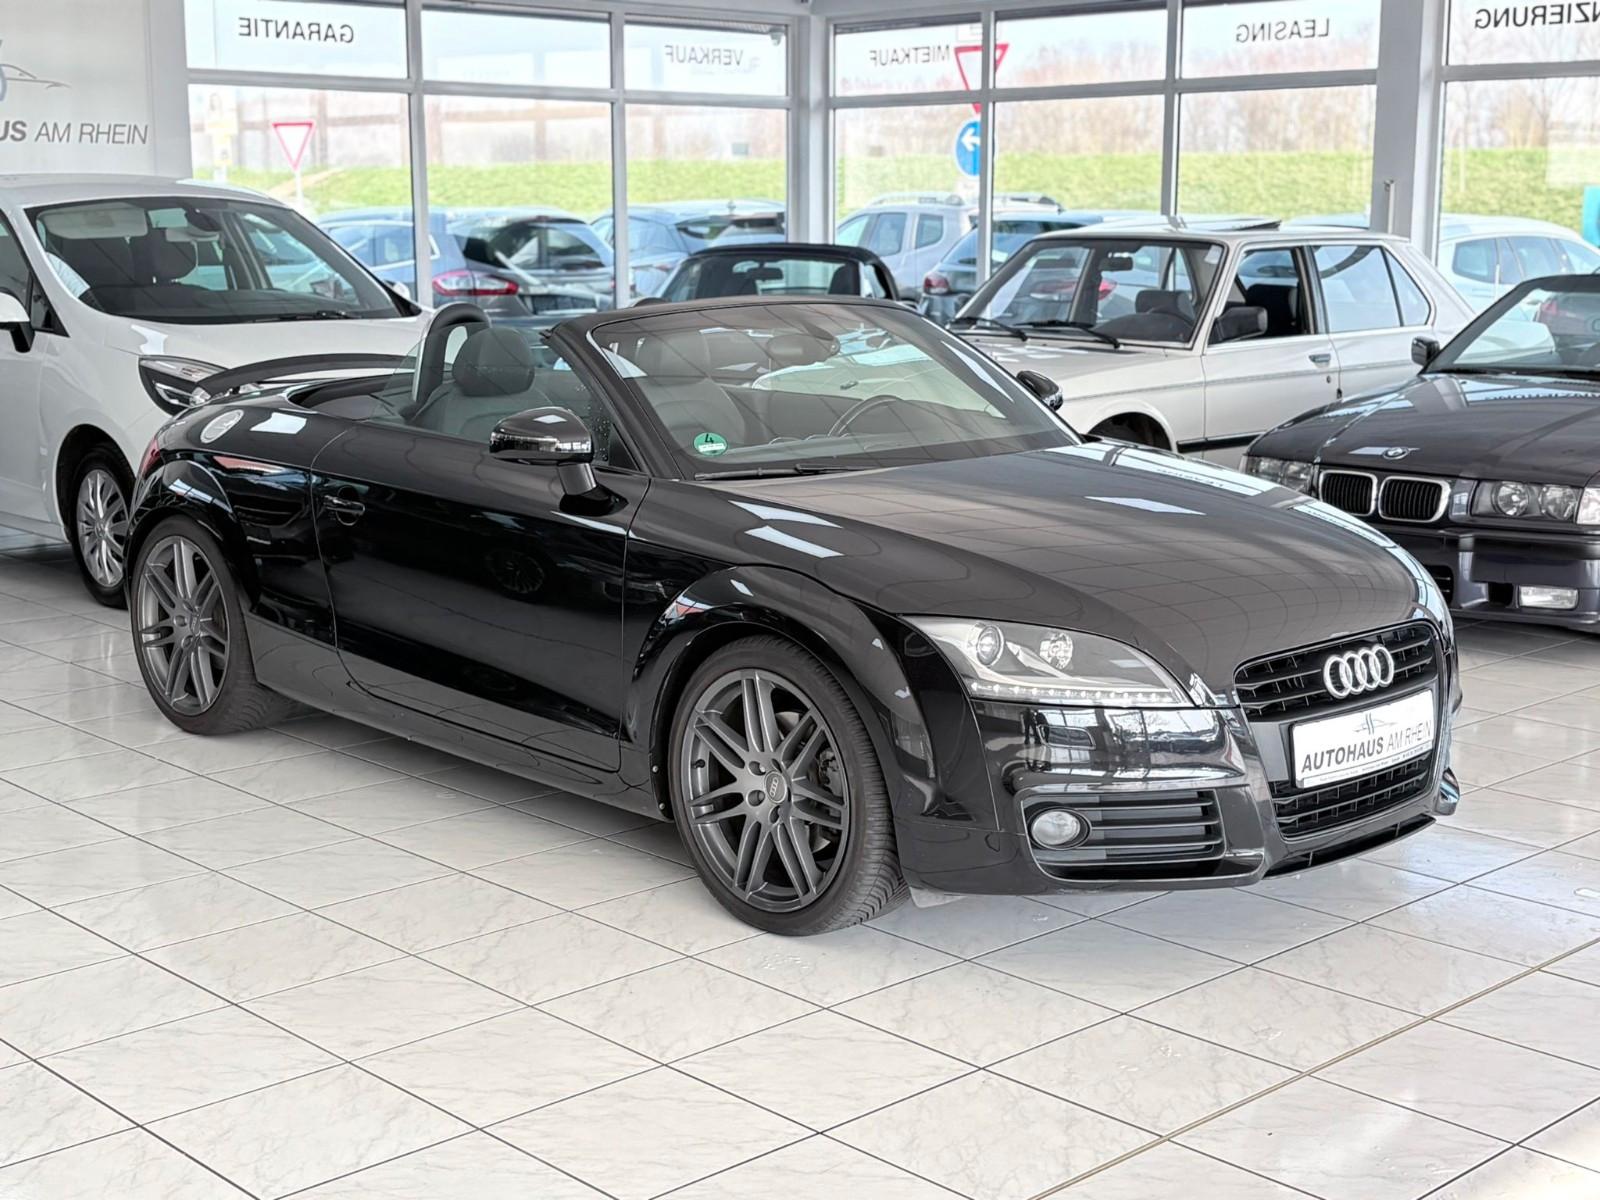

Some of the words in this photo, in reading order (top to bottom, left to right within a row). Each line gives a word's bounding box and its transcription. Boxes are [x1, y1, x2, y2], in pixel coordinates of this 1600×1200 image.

[34, 121, 71, 143] AM
[79, 122, 148, 144] RHEIN
[704, 433, 714, 443] 4
[1301, 736, 1384, 773] AUTOHAUS
[1386, 732, 1403, 752] AM
[1405, 719, 1432, 745] RHEIN
